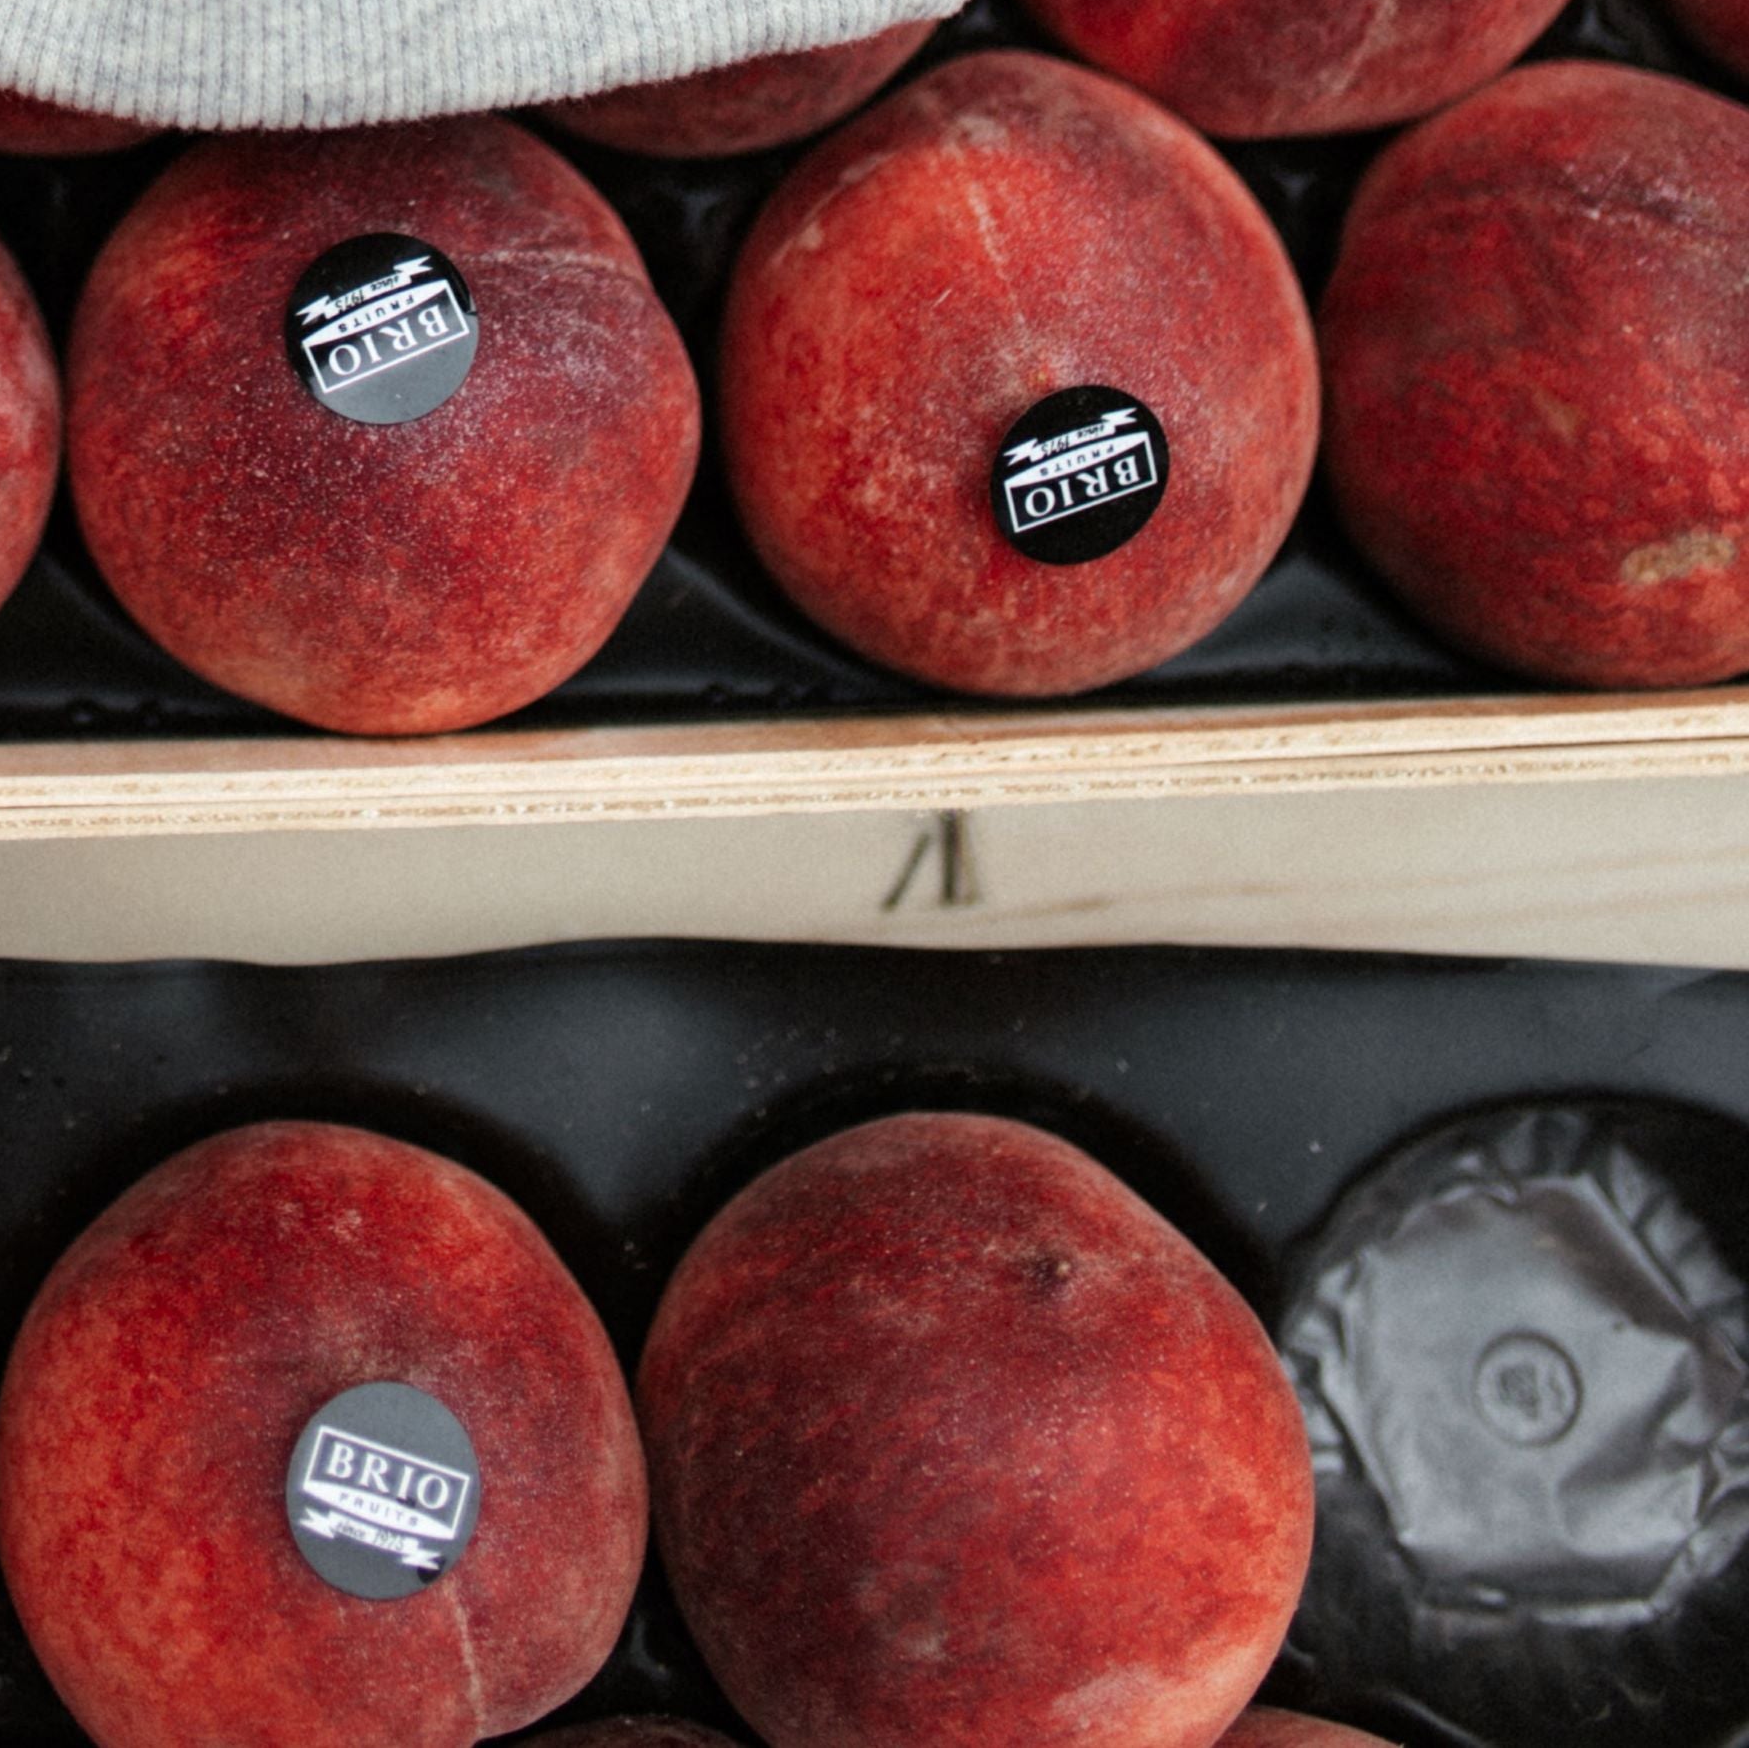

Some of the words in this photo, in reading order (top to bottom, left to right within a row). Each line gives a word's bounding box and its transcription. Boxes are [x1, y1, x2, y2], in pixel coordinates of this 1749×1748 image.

[332, 286, 366, 313] 1975
[369, 273, 401, 294] since
[335, 294, 415, 334] FRUITS
[328, 306, 450, 376] BRIO
[1039, 432, 1072, 456] 1975
[1076, 422, 1106, 442] since
[1038, 443, 1114, 477] FRUITS
[1025, 454, 1140, 518] BRIO
[326, 1440, 450, 1510] BRIO
[339, 1493, 419, 1527] FRUITS
